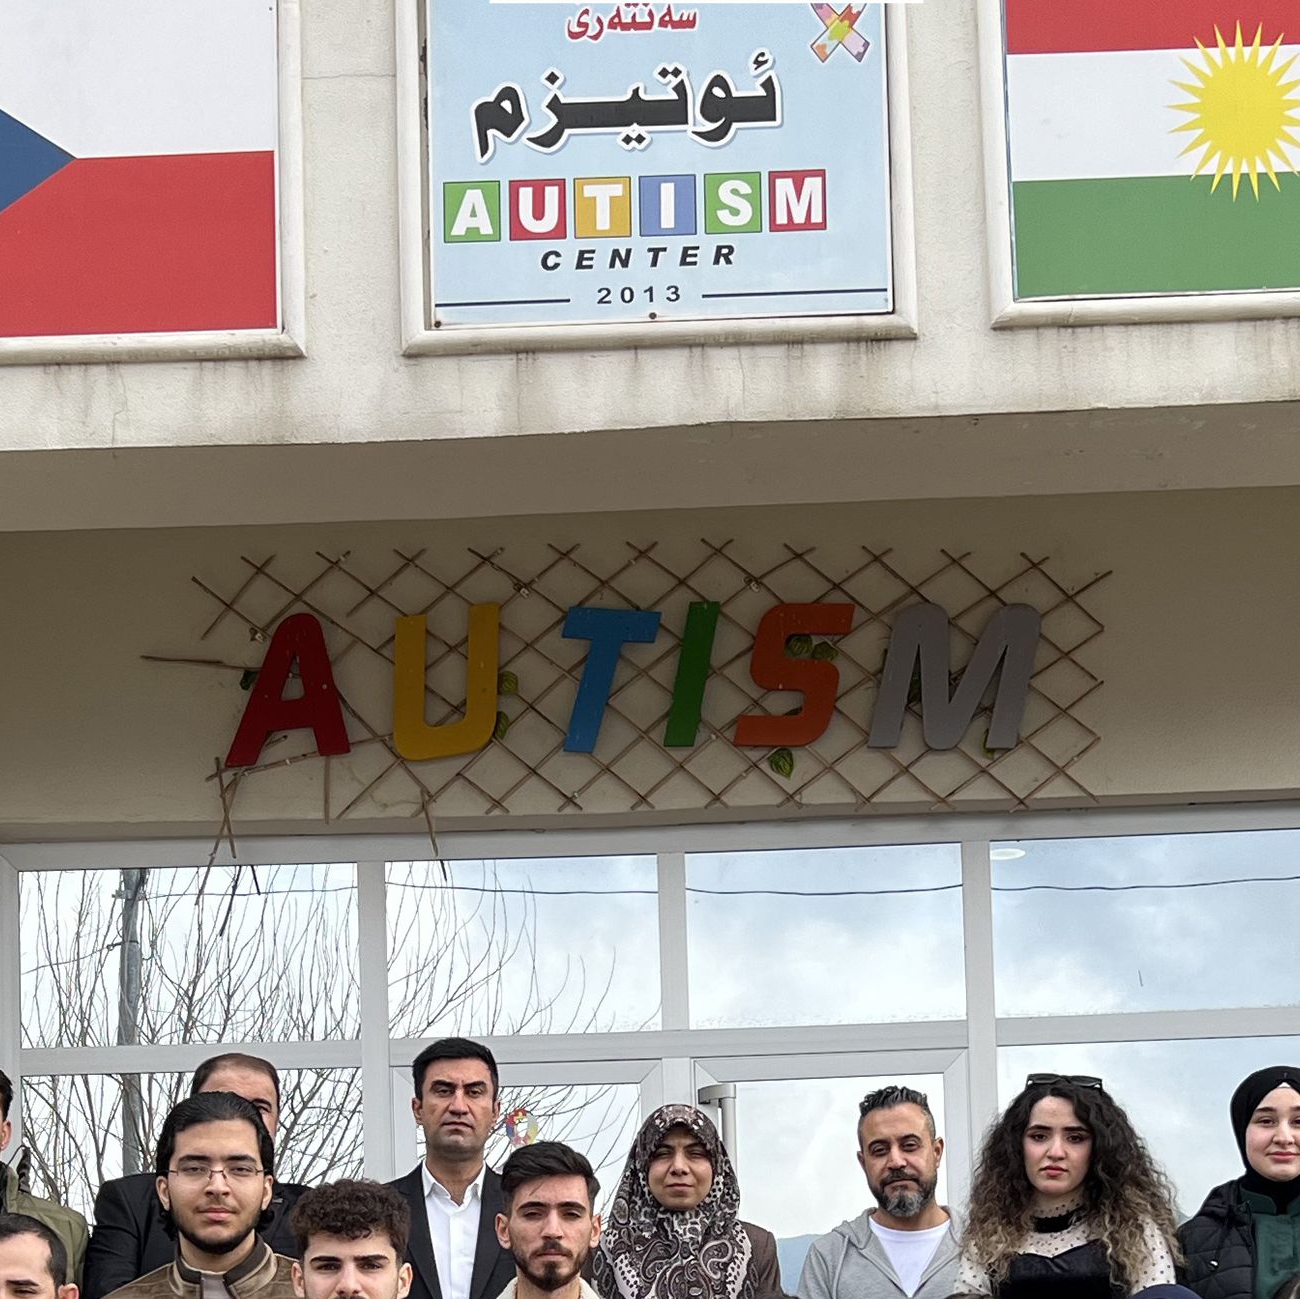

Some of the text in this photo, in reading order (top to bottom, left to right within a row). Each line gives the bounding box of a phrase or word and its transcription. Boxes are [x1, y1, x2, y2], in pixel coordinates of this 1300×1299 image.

[450, 176, 824, 237] AUTISM
[540, 244, 736, 271] CENTER
[596, 285, 682, 305] 2013
[225, 600, 1041, 768] AUTISM
